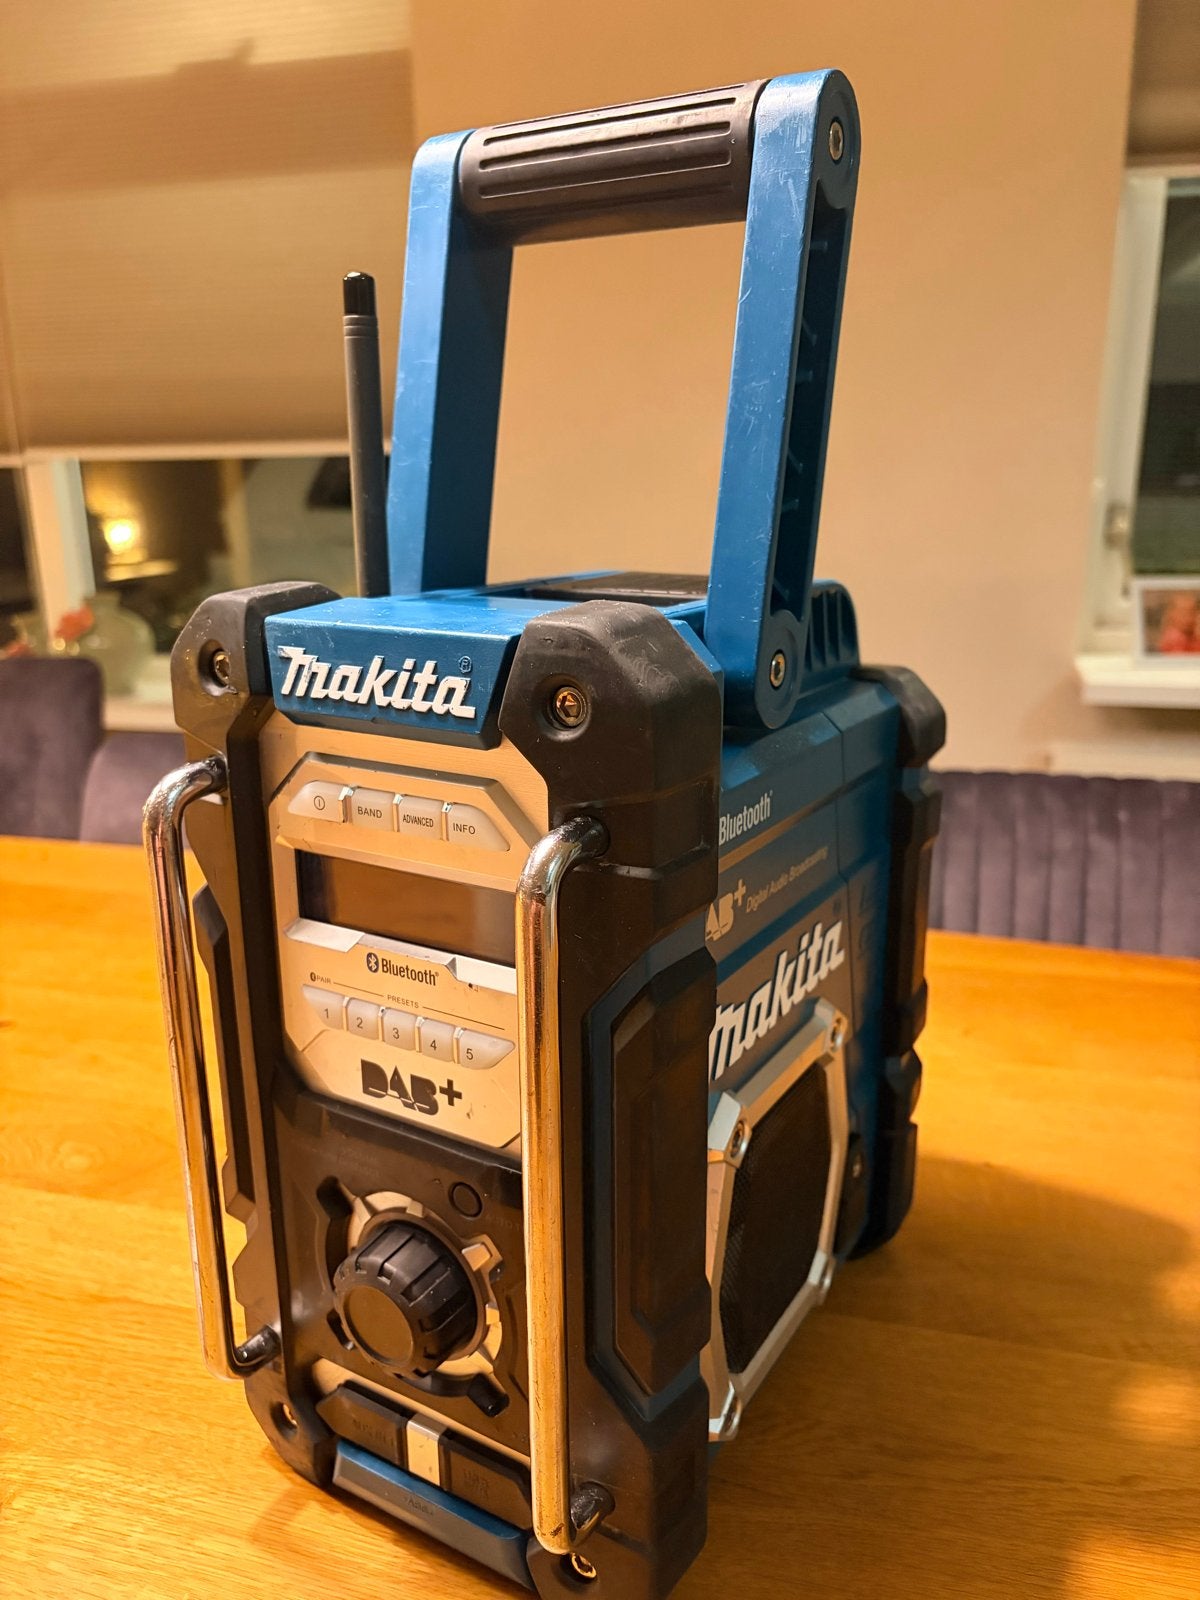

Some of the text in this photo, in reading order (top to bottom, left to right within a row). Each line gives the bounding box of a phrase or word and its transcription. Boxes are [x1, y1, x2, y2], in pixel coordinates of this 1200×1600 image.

[357, 805, 383, 819] BAND
[402, 813, 434, 828] ADVANCED
[718, 792, 771, 846] Bluetooth
[452, 822, 476, 835] INFO
[705, 878, 747, 941] AB+
[316, 974, 332, 984] PAIR
[381, 957, 436, 986] Bluetooth
[387, 994, 419, 1009] PRESETS
[324, 1008, 474, 1060] 1 2 3 4 5
[360, 1058, 463, 1116] DAB+
